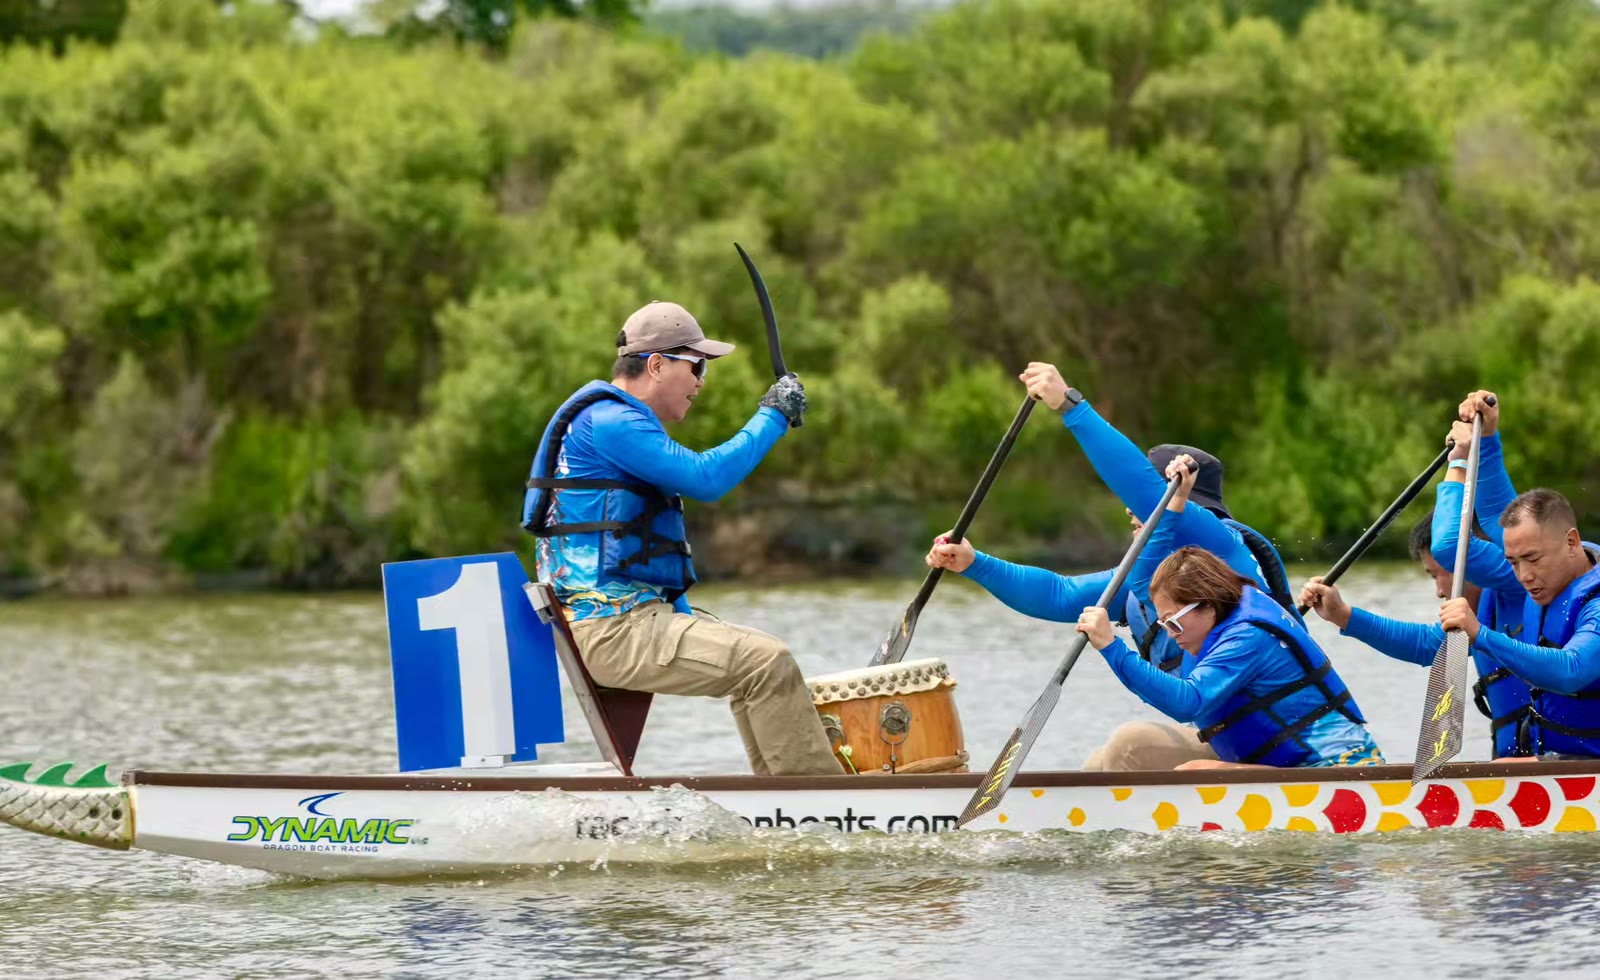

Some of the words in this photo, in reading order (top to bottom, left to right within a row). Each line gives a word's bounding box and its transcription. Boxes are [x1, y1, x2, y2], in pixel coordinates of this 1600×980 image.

[416, 561, 517, 756] 1
[227, 816, 415, 845] DYNAMIC
[263, 843, 306, 852] DRAGON
[310, 844, 337, 853] BOAT
[341, 845, 379, 854] RACING
